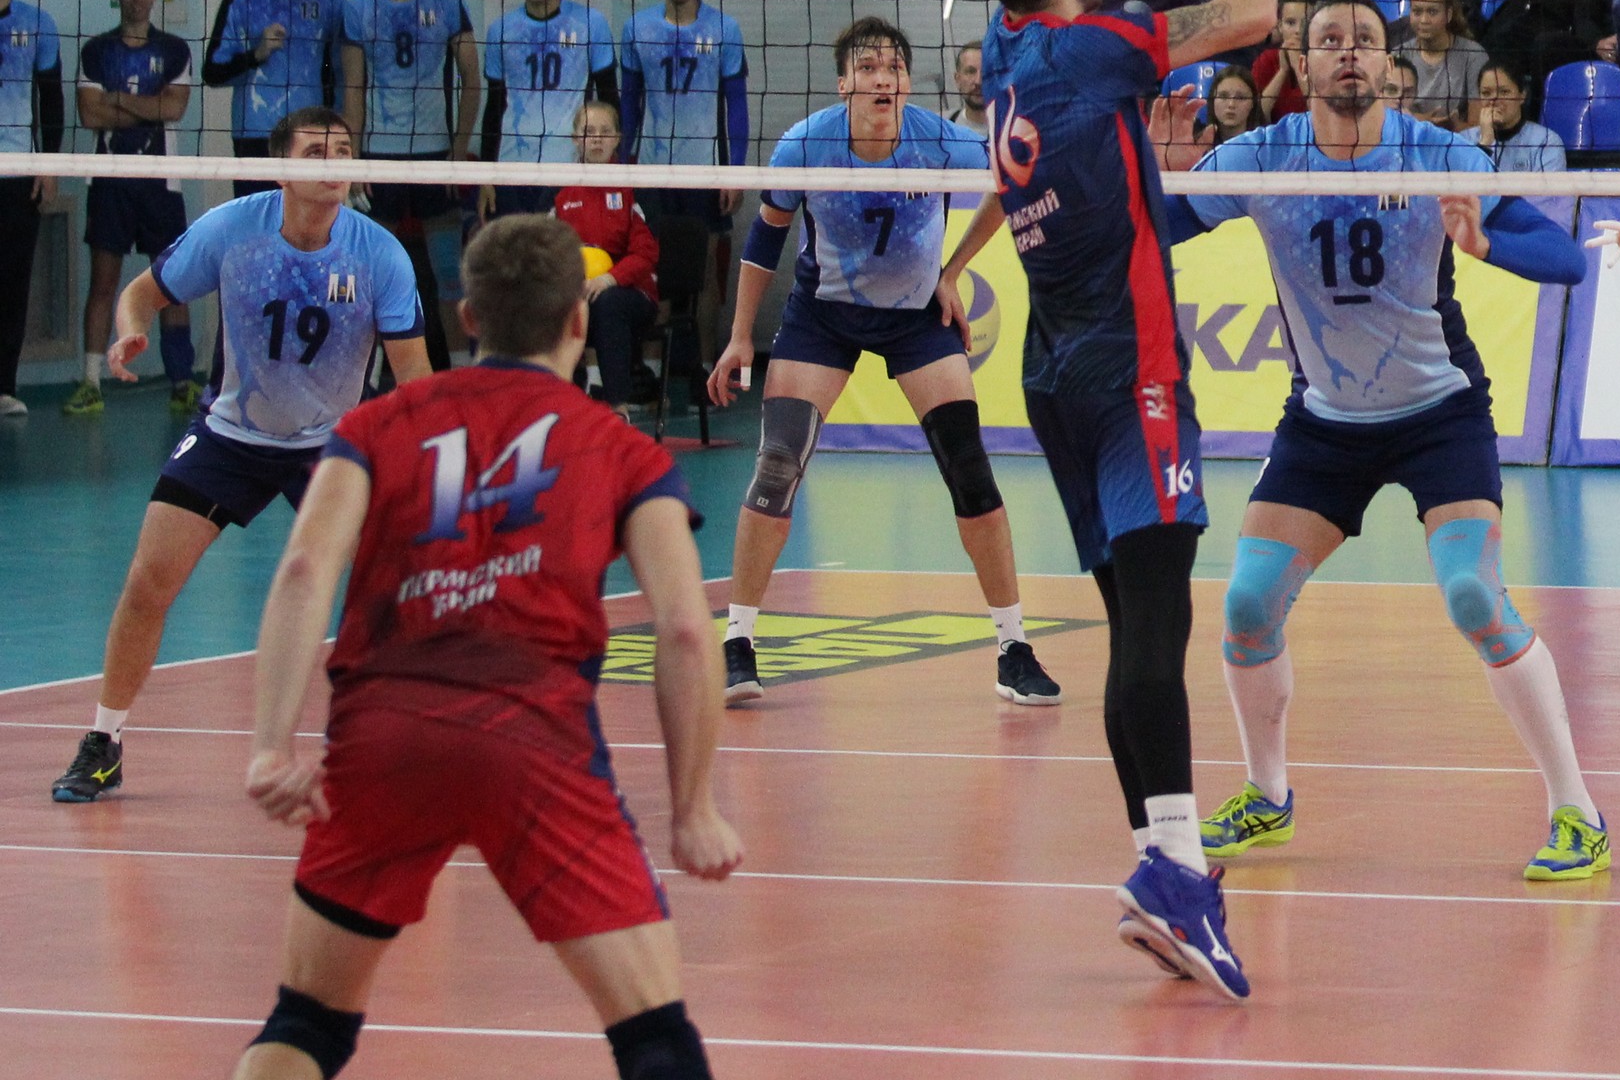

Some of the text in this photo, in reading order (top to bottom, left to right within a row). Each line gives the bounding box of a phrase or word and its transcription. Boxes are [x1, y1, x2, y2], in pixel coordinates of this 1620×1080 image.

[396, 32, 414, 69] 8
[525, 51, 562, 91] 10
[661, 56, 699, 95] 17
[985, 84, 1042, 196] 16
[863, 207, 896, 257] 7
[1309, 218, 1385, 289] 18
[262, 298, 331, 366] 19
[412, 412, 560, 545] 14
[1165, 458, 1194, 499] 16
